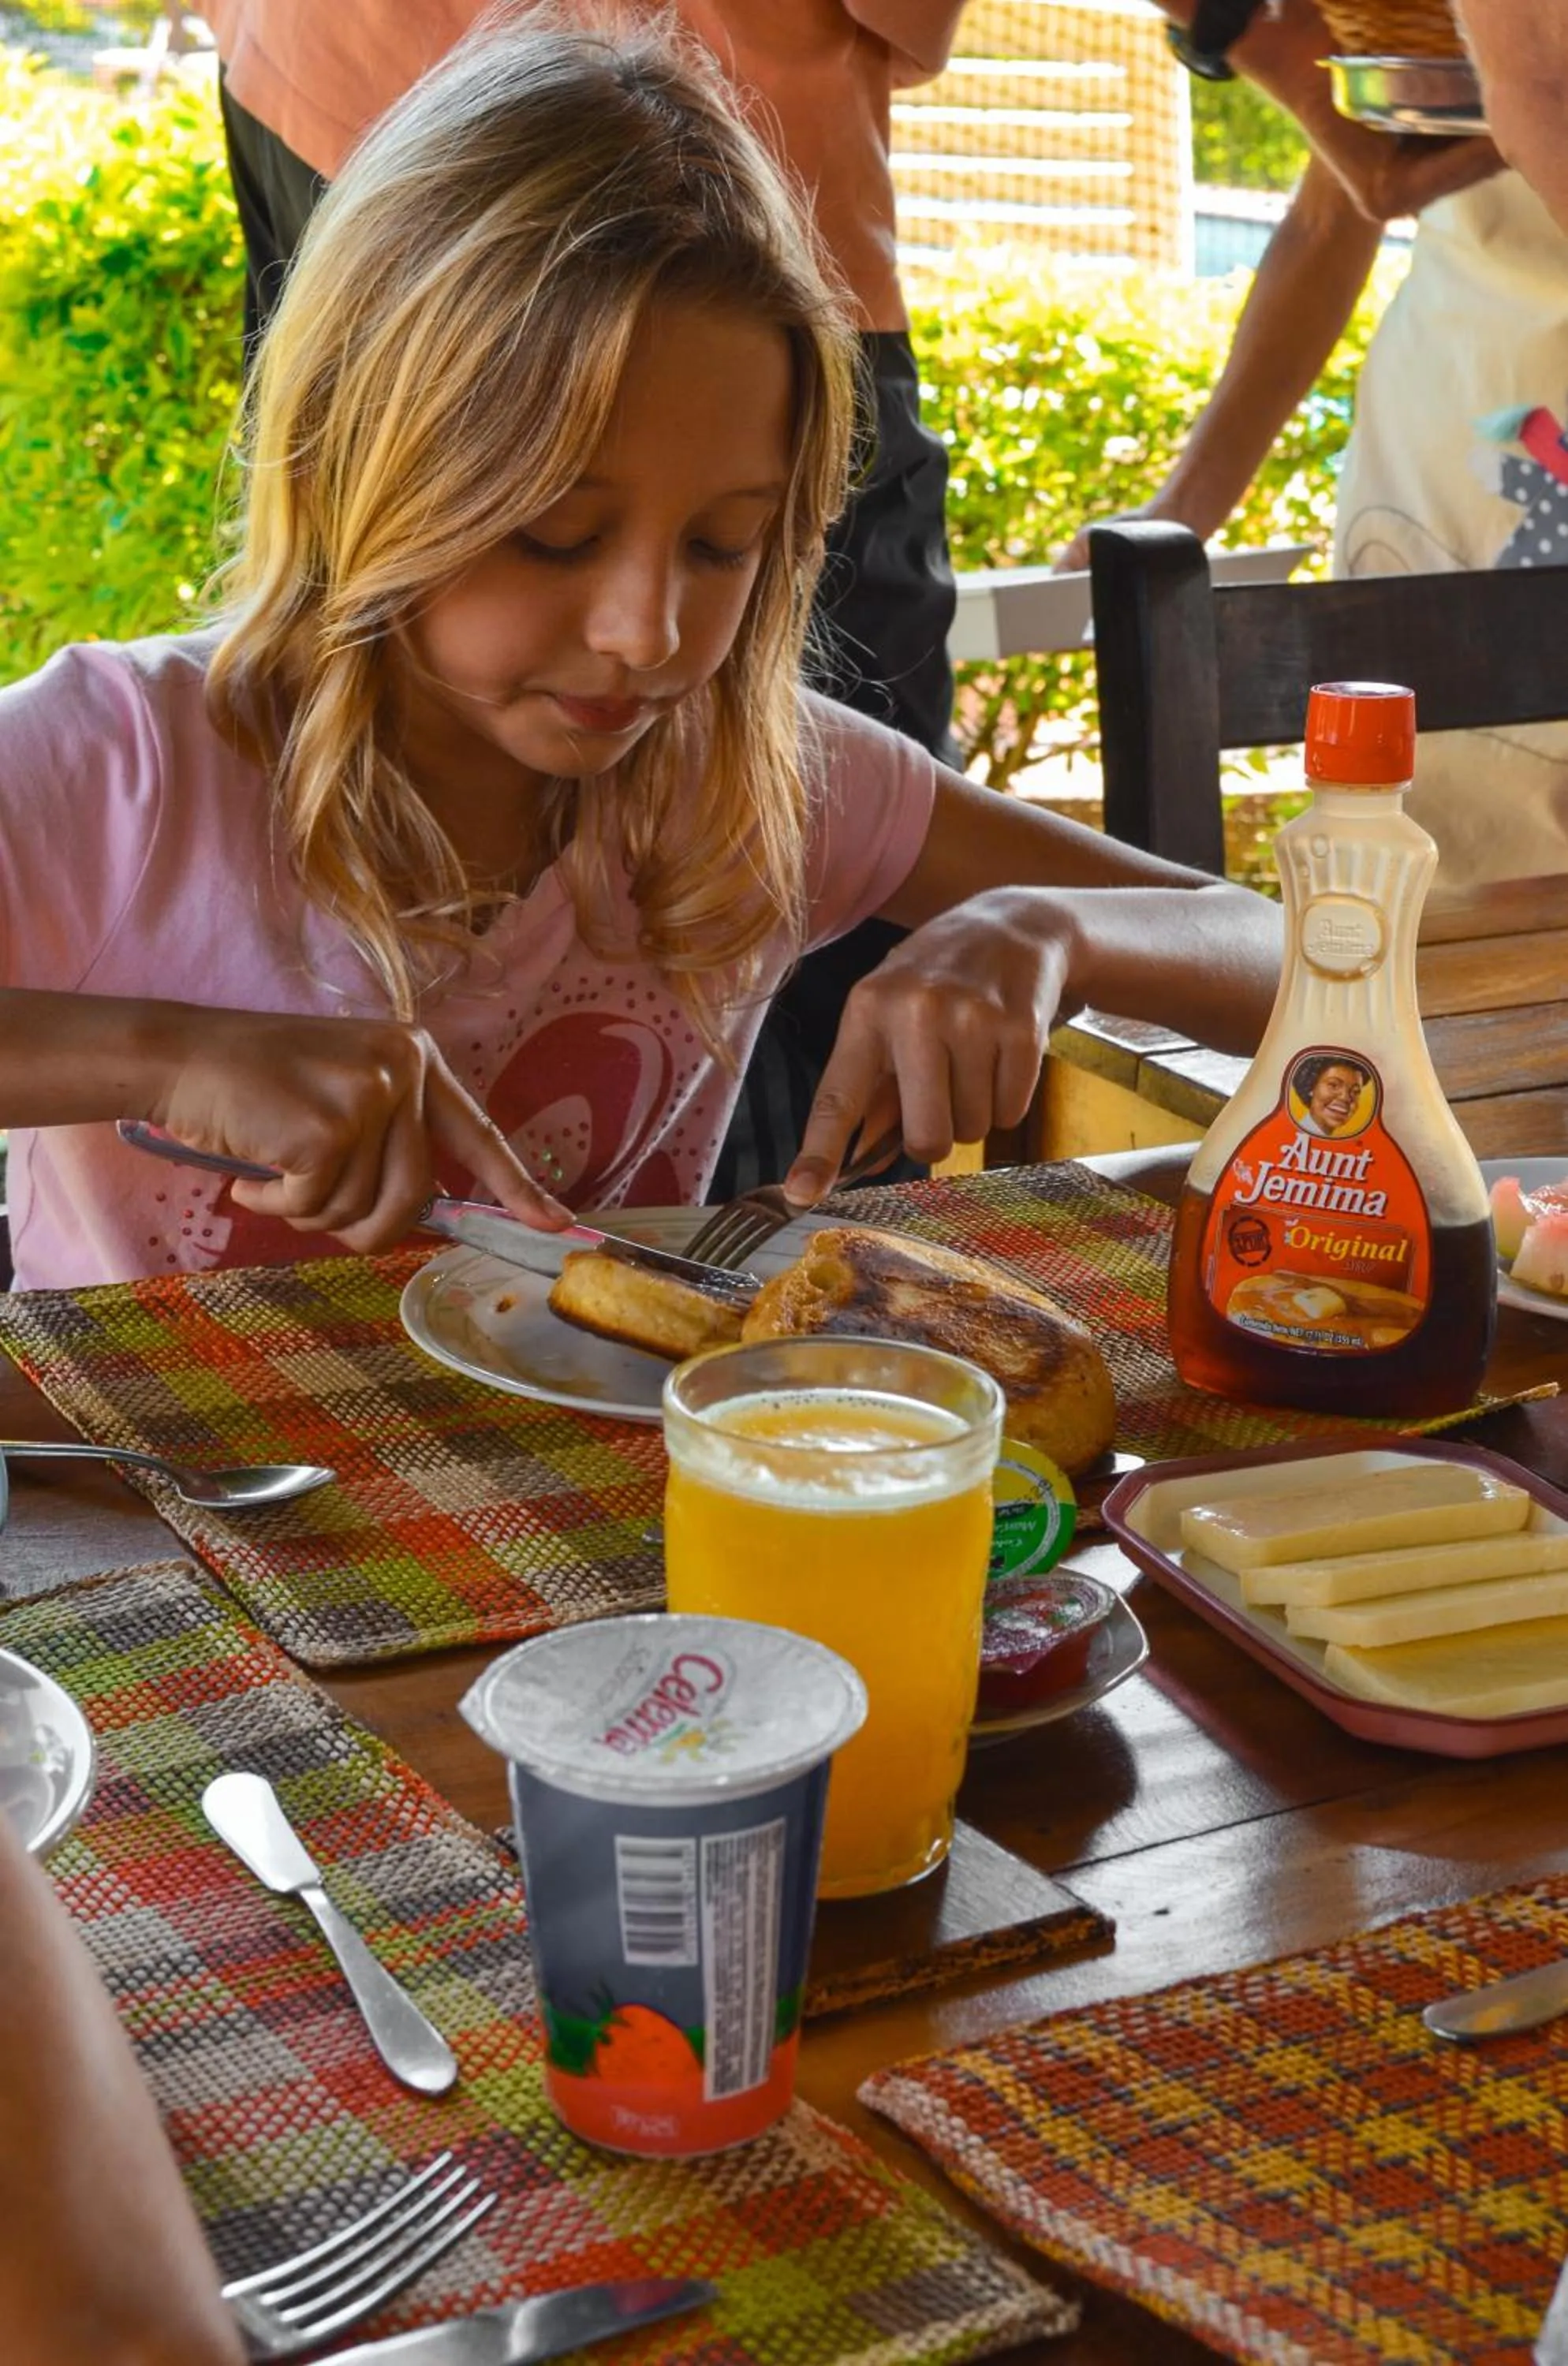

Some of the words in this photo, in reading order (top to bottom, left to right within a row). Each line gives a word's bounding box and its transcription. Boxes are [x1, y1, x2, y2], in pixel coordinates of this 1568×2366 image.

[1278, 1132, 1374, 1181] Aunt
[1234, 1160, 1388, 1218] Jemima
[1289, 1225, 1408, 1262] Original
[593, 1653, 724, 1756] Celema
